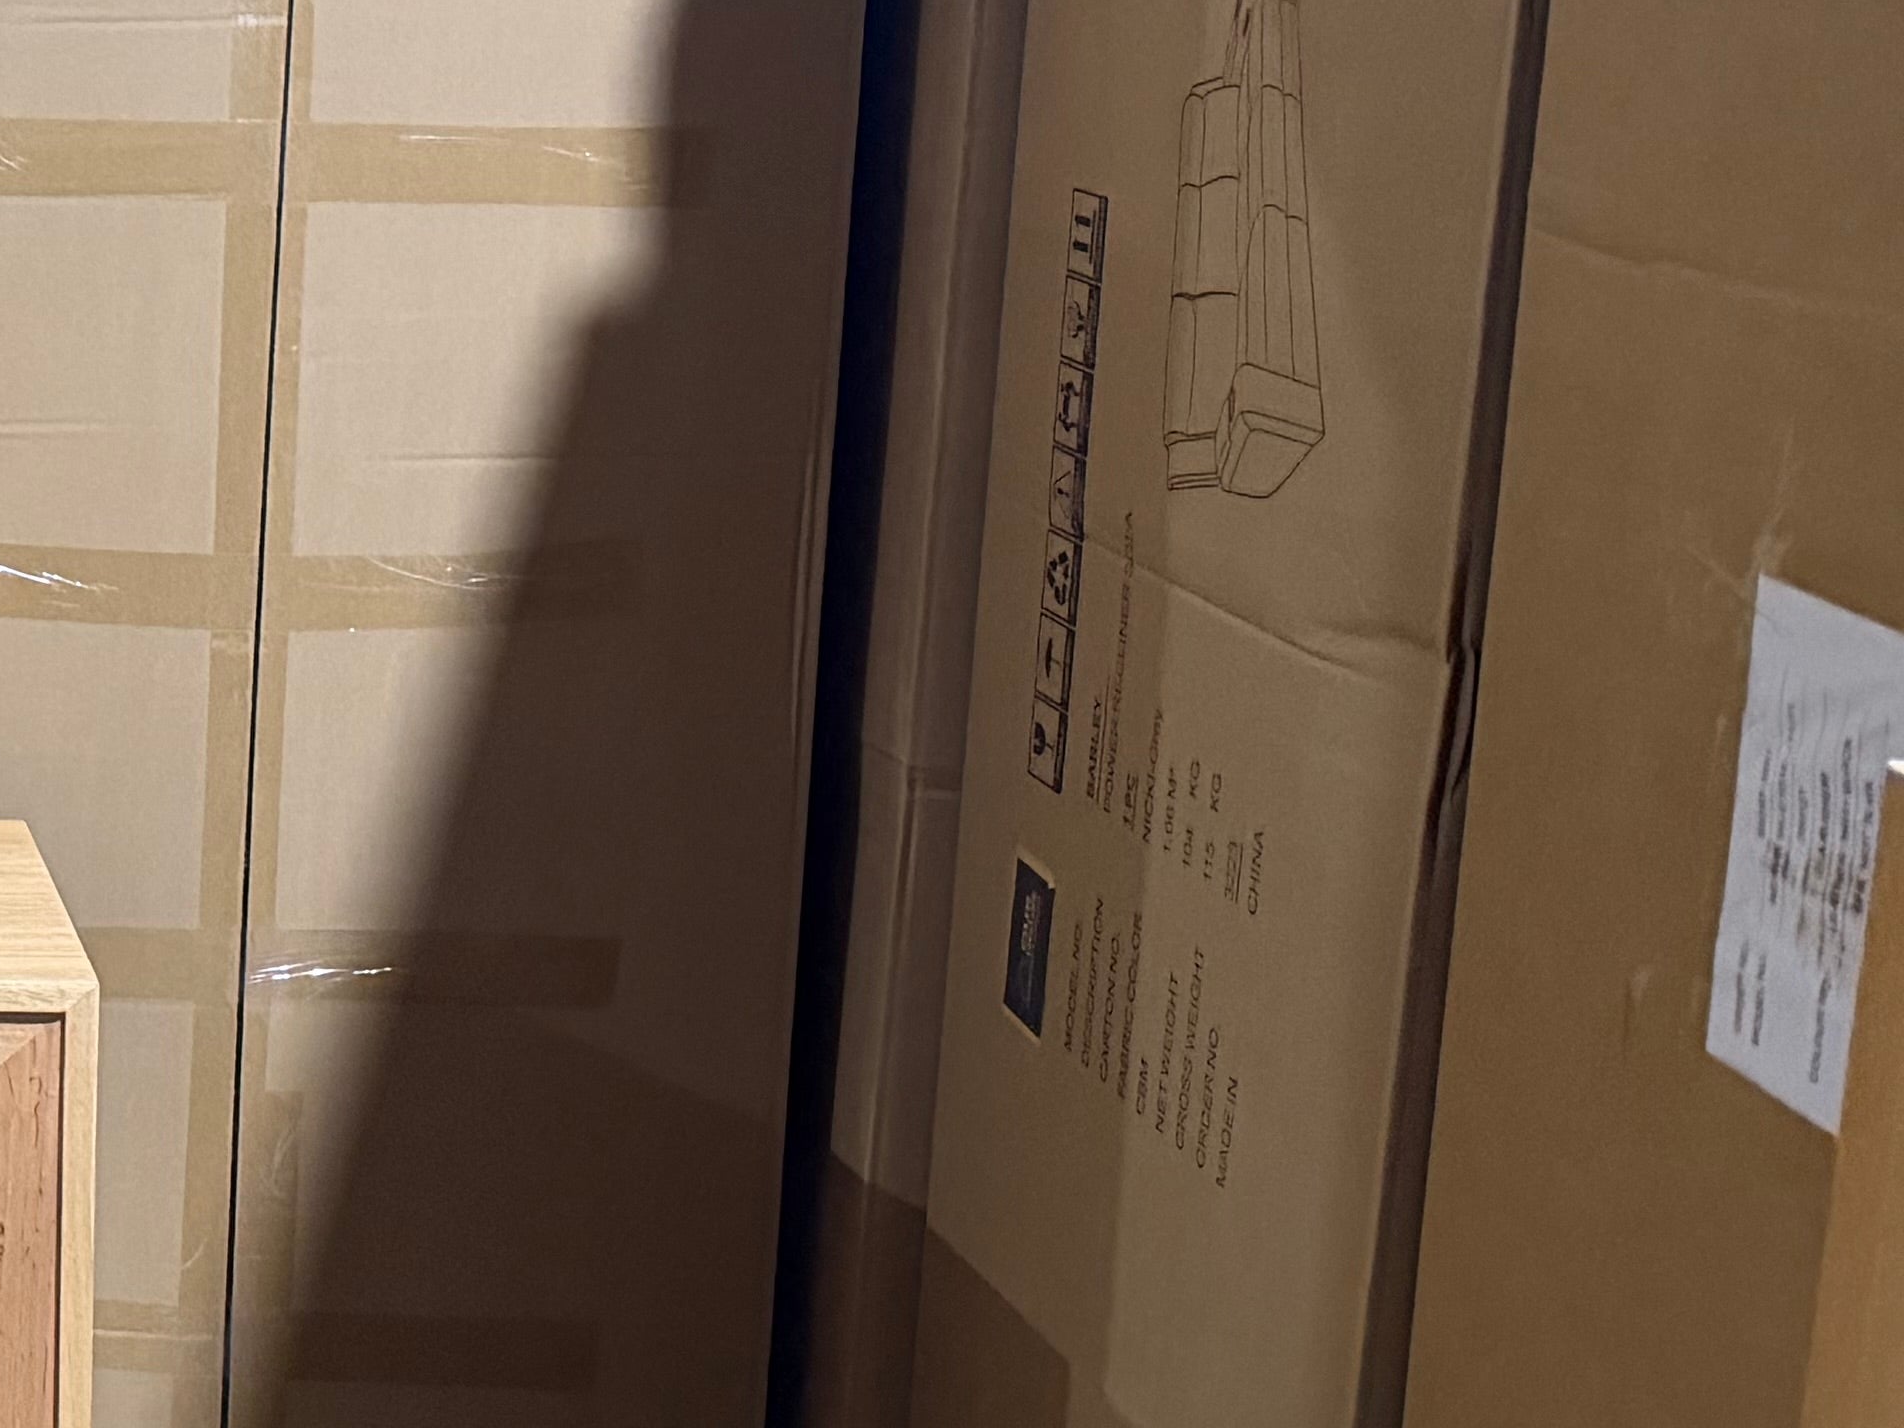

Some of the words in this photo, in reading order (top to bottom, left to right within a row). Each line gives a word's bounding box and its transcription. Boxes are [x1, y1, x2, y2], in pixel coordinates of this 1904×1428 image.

[1189, 760, 1200, 799] KG
[1082, 897, 1104, 1069] DESCRIPTION
[1117, 1007, 1134, 1100] FABRIC
[1127, 910, 1142, 1003] COLOR
[1175, 1057, 1192, 1150] GROSS
[1185, 943, 1205, 1051] WEIGHT
[1210, 772, 1222, 813] KG
[1215, 1108, 1235, 1189] MADE
[1247, 831, 1265, 916] CHINA
[1100, 978, 1116, 1084] CARTON
[1160, 972, 1179, 1076] WEIGHT
[1136, 1057, 1149, 1115] CBM
[1156, 1080, 1168, 1134] NET
